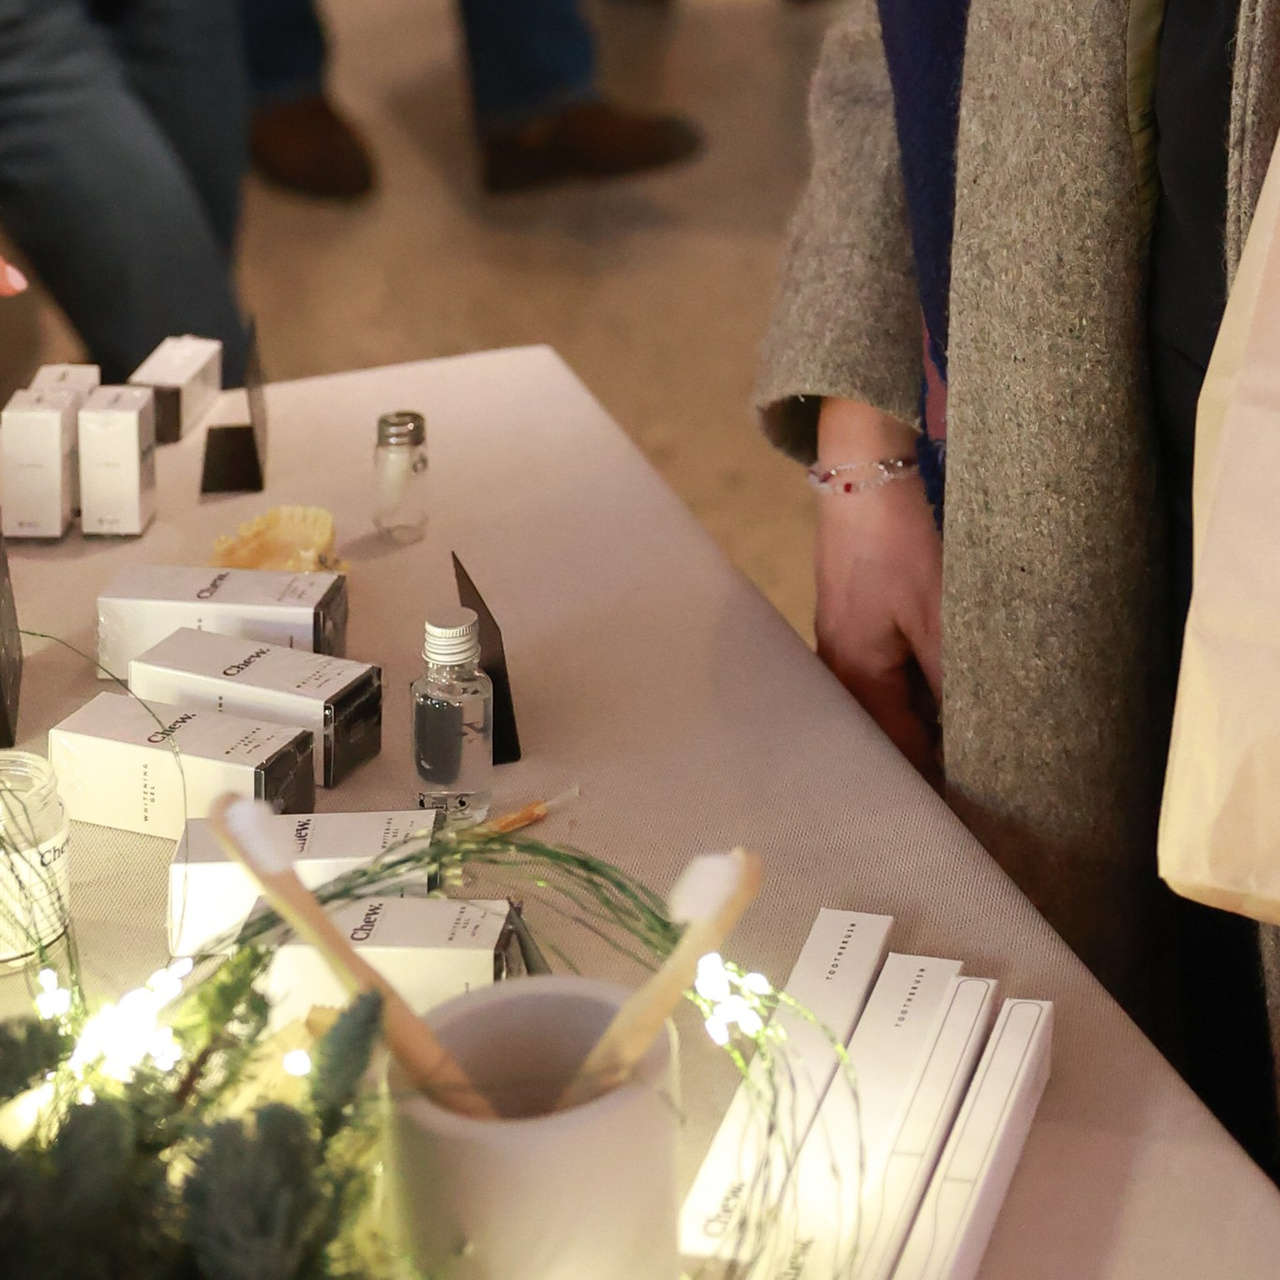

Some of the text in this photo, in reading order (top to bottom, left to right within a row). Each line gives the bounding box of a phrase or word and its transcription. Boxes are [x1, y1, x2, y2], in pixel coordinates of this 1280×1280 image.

[222, 647, 270, 677] Chew.
[147, 712, 197, 744] Chew.
[40, 837, 70, 867] Che
[350, 902, 383, 942] Chew.
[825, 922, 856, 981] TOOTHBRUSH
[894, 968, 925, 1027] TOOTHBRUSH
